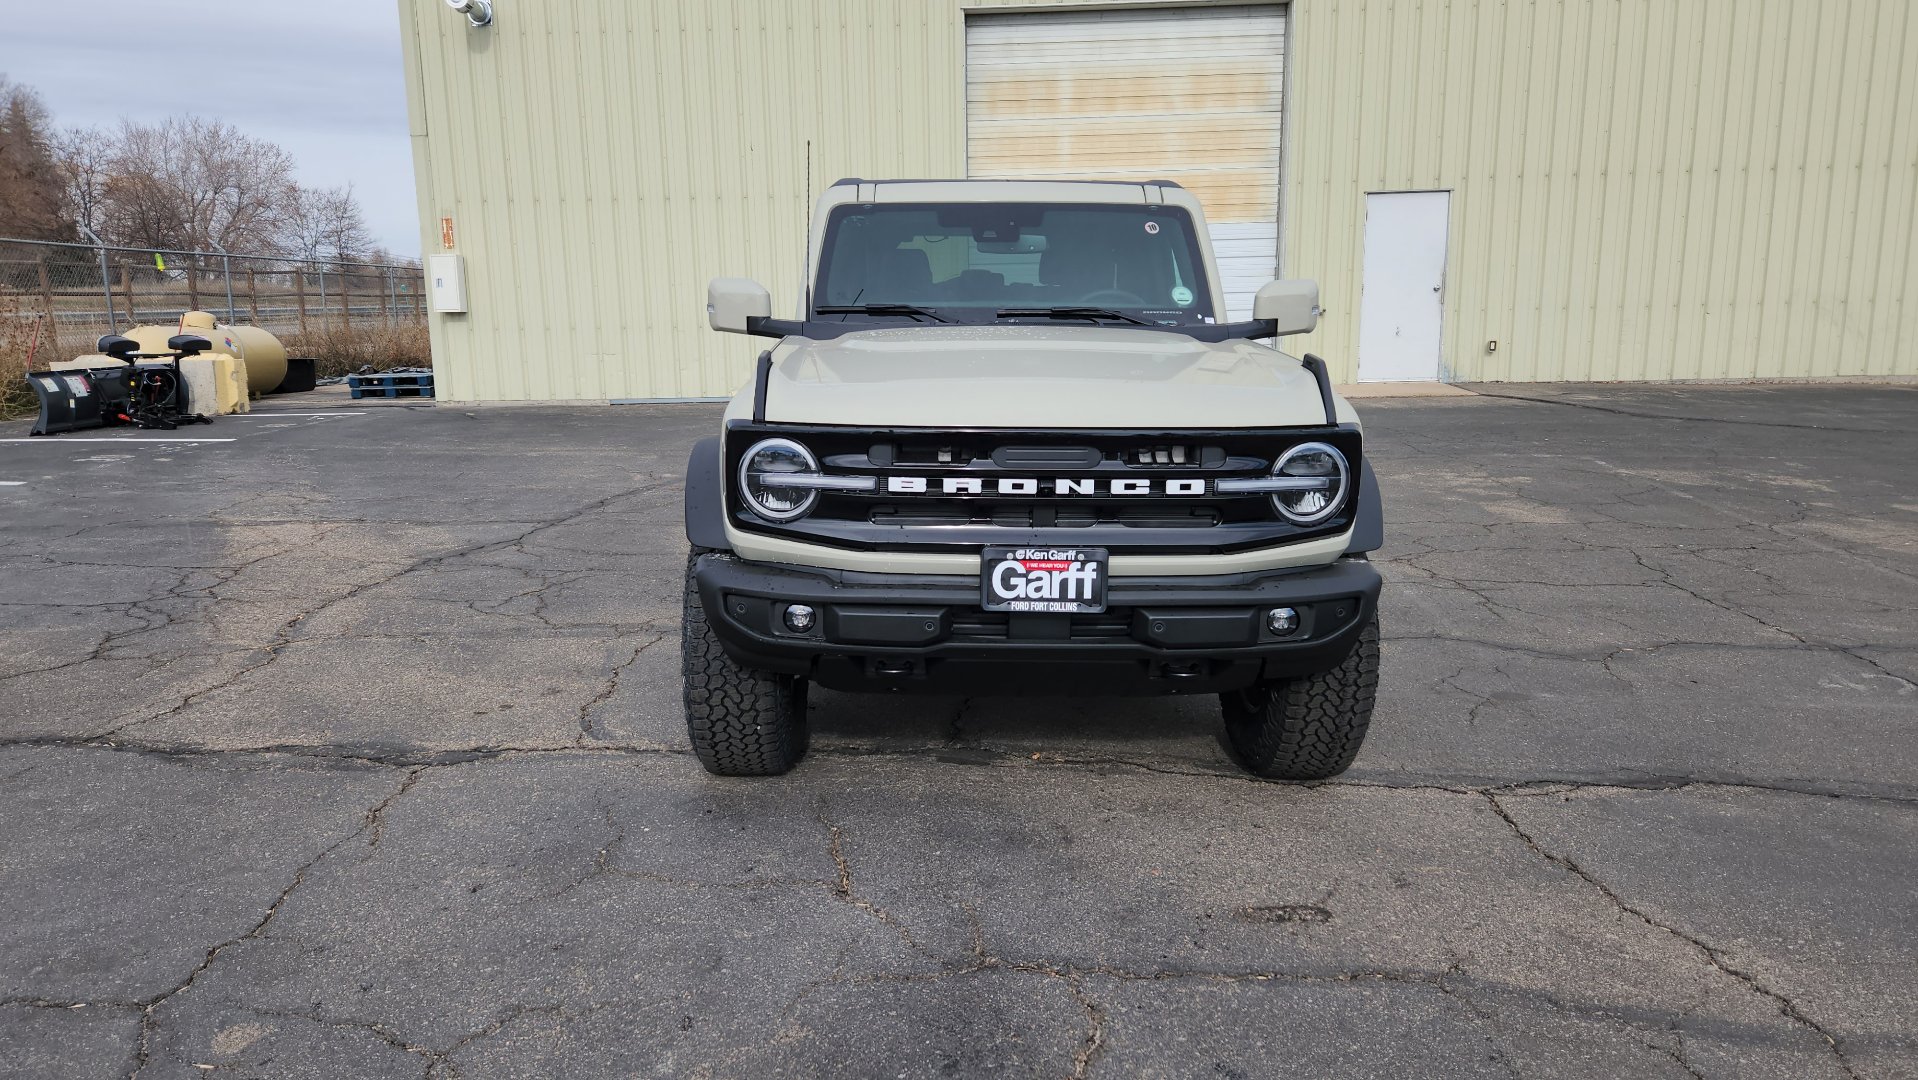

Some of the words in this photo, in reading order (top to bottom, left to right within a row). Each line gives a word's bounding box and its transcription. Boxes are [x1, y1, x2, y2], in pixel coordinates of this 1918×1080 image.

[888, 476, 1205, 494] BRONCO
[1026, 549, 1047, 560] Ken
[1048, 550, 1076, 560] Garff
[992, 560, 1097, 599] Garff
[1011, 602, 1030, 611] FORD
[1030, 602, 1048, 611] FORT
[1049, 602, 1078, 612] COLLINS
